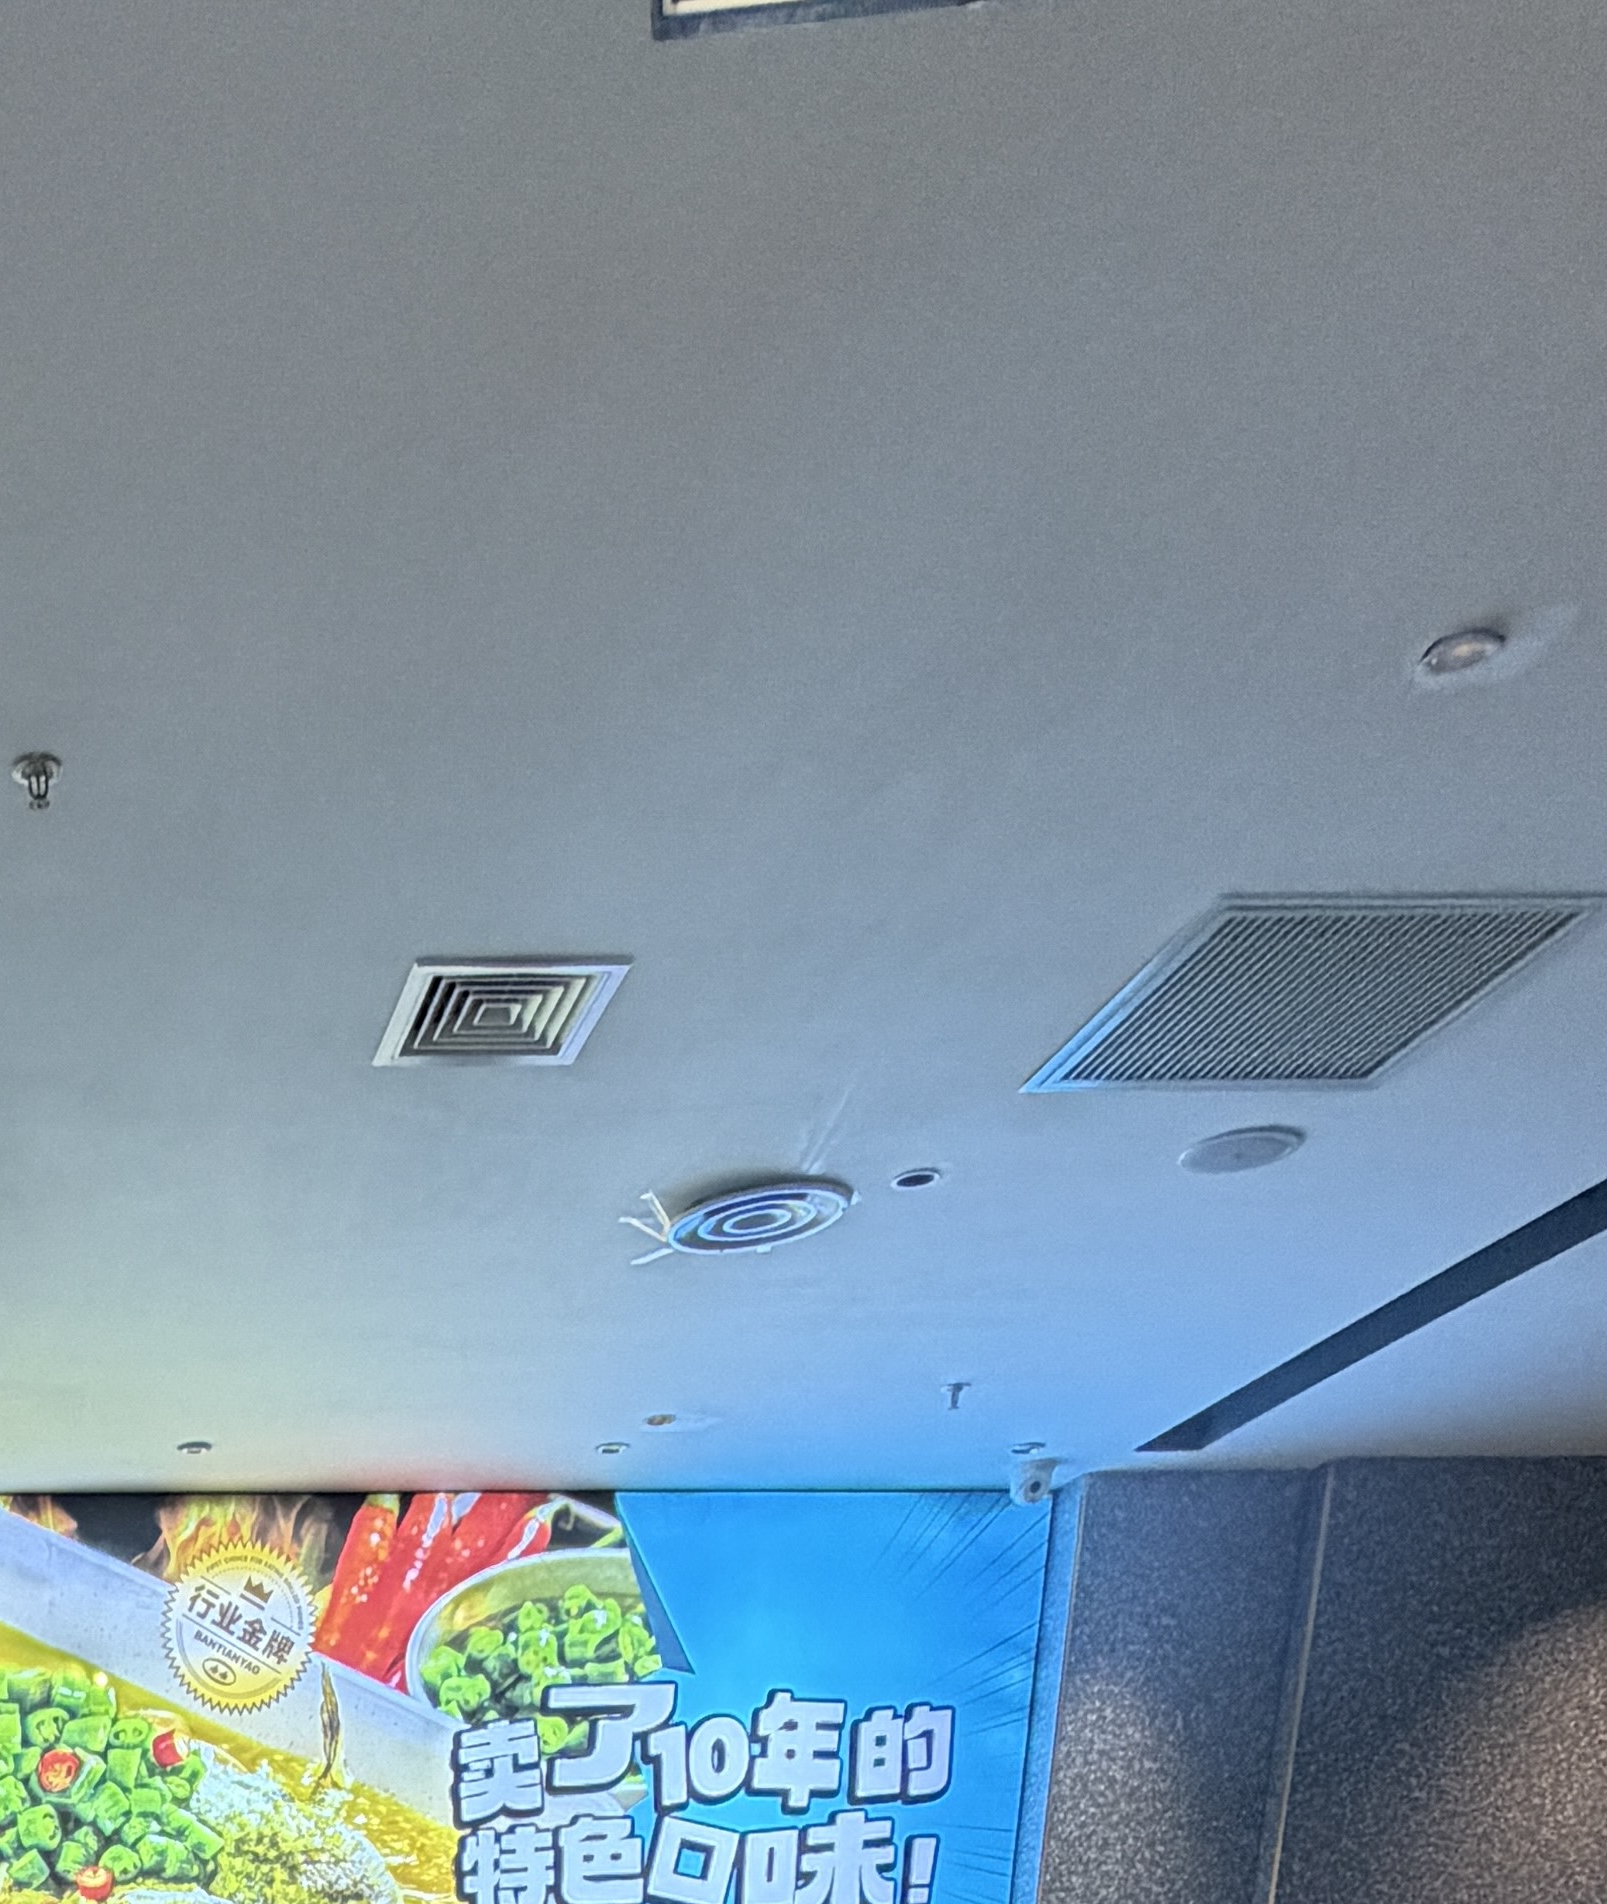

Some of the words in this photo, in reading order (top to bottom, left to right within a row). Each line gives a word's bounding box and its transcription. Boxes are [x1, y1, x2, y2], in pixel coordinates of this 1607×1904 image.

[187, 1584, 295, 1666] 行业金牌
[193, 1629, 261, 1675] BANTIANYAO
[454, 1680, 956, 1828] 卖了10年的
